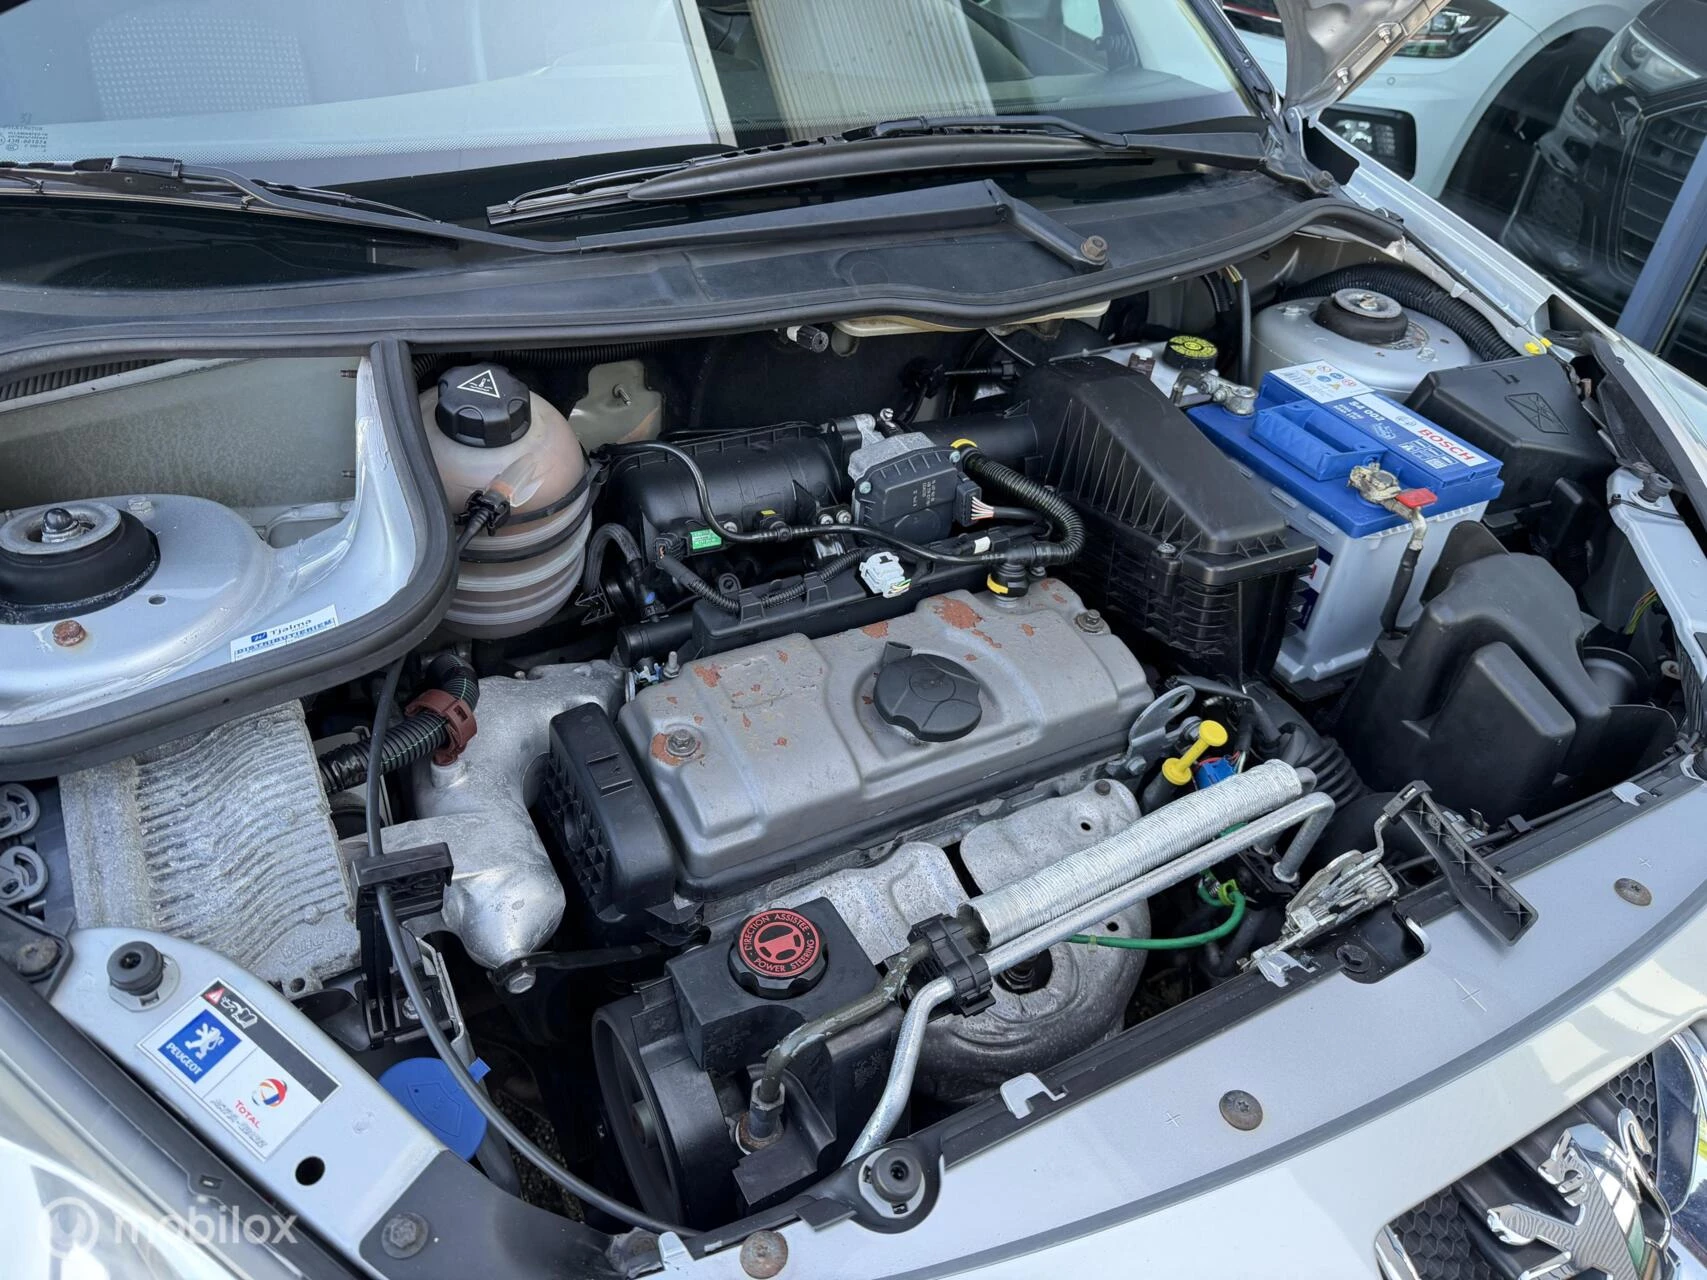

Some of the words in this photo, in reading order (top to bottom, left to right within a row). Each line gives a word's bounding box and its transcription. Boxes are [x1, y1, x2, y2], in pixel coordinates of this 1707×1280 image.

[1363, 409, 1385, 421] 002
[1418, 428, 1476, 461] BOSCH
[236, 619, 332, 655] DISTRIBUTIERIEM
[271, 619, 312, 636] Tjalma
[743, 915, 770, 951] DIRECTION
[774, 913, 810, 932] ASSISTEE
[753, 958, 786, 972] POWER
[790, 939, 815, 970] STEERING
[165, 1042, 204, 1075] PEUGEOT
[234, 1099, 262, 1129] TOTAL
